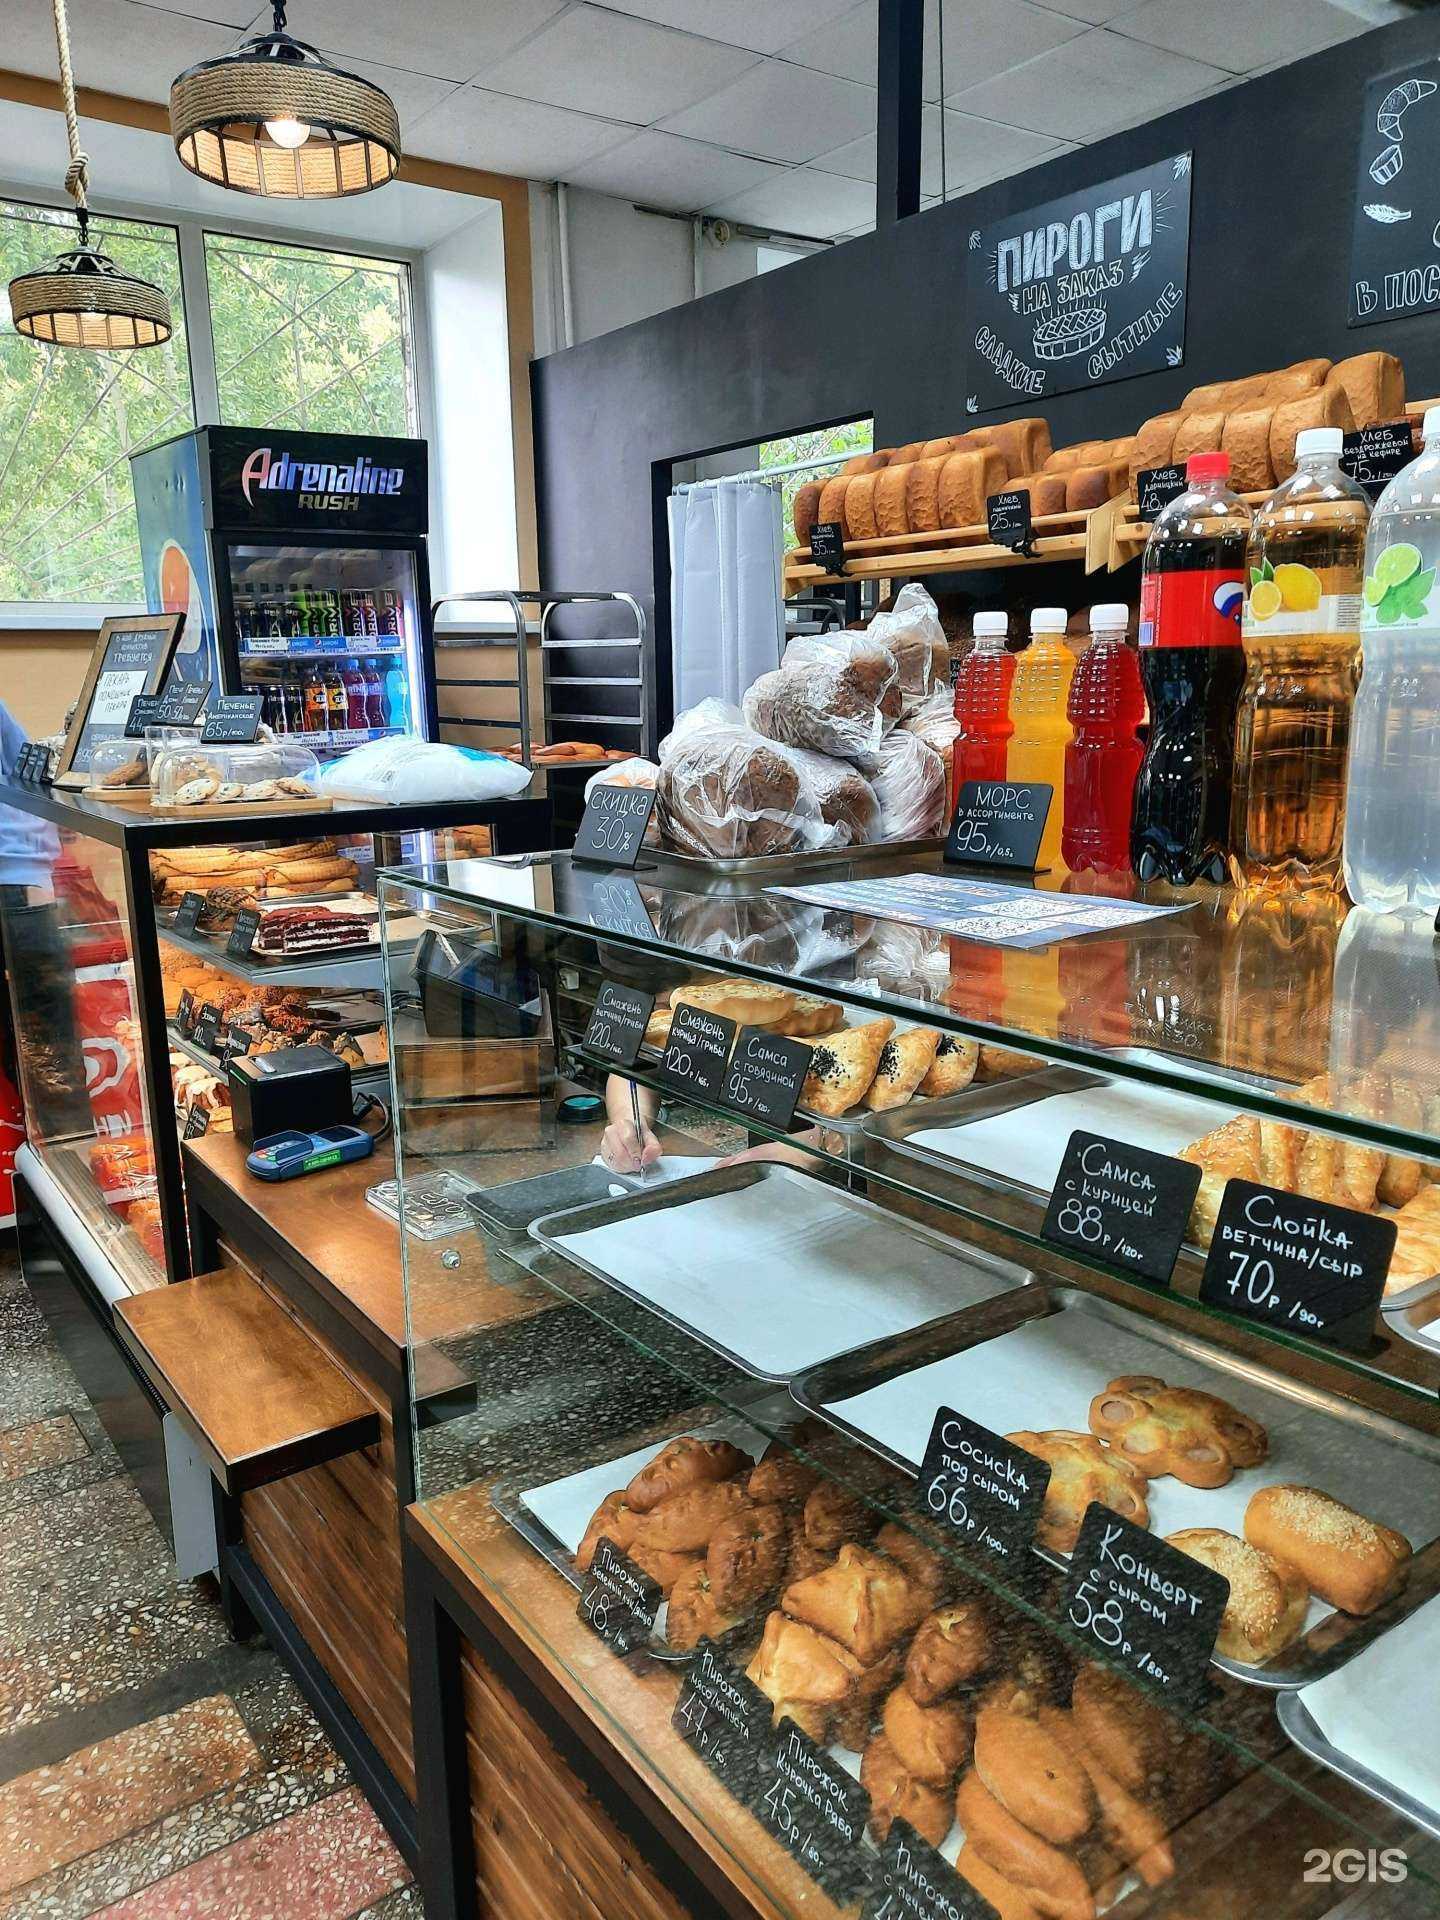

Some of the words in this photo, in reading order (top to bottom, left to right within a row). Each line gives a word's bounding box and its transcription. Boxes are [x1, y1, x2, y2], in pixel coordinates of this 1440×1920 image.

[998, 189, 1152, 292] ПИРОГИ
[1022, 282, 1051, 315] НА
[1057, 260, 1124, 304] ЗАКАЗ
[1384, 265, 1440, 310] ПОС
[1088, 282, 1182, 378] СЫТНЫЕ
[975, 326, 1046, 394] СЛАДКИЕ
[241, 448, 405, 508] Adrenaline
[298, 494, 360, 511] RUSH
[975, 786, 1031, 809] МОРС
[591, 816, 634, 854] 30%
[680, 1009, 725, 1041] Смажень
[747, 1037, 788, 1068] Самса
[743, 1062, 797, 1089] говядиной
[1065, 1179, 1077, 1191] с
[1081, 1178, 1158, 1217] курицей
[941, 1453, 968, 1483] под
[972, 1473, 1021, 1511] сыром
[1109, 1579, 1167, 1624] сыром
[824, 1799, 853, 1841] Ряба
[897, 1841, 964, 1920] Пирожо
